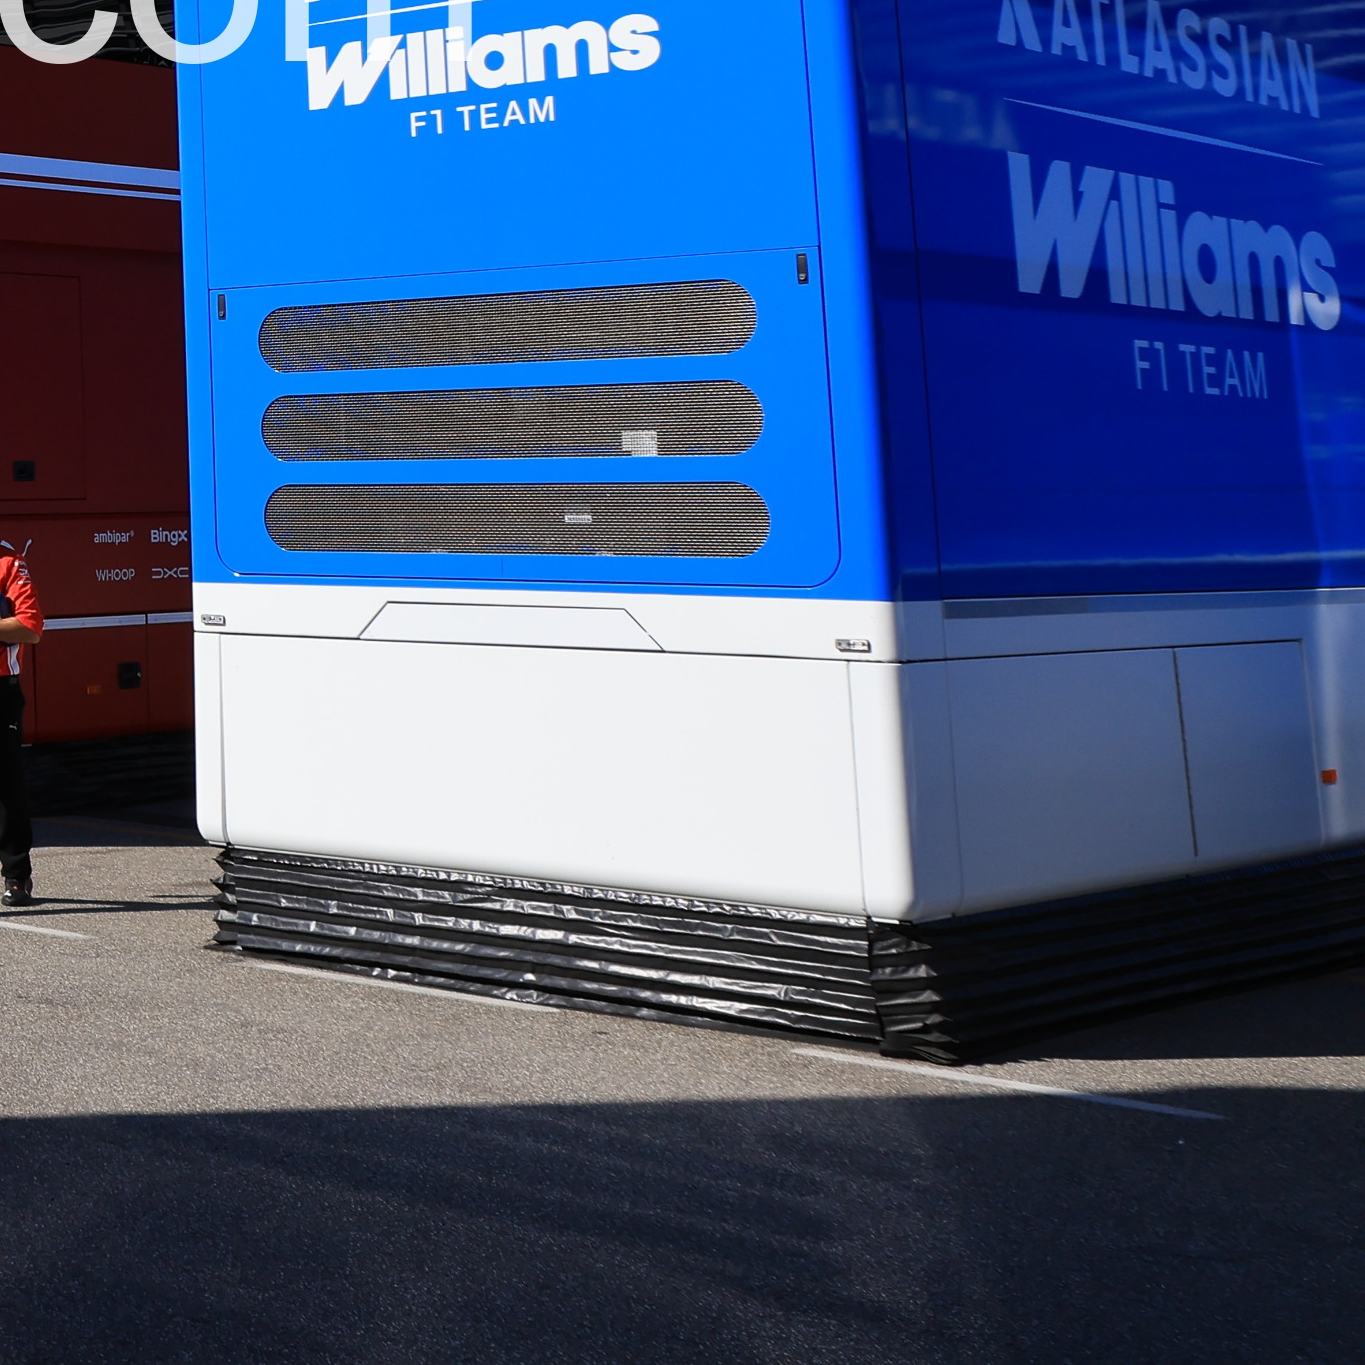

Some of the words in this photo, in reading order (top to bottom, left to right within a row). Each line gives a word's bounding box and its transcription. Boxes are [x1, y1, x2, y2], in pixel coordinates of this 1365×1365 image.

[306, 13, 661, 111] Williams
[410, 109, 444, 138] F1
[456, 95, 556, 132] TEAM
[1007, 150, 1342, 331] Williams
[1133, 339, 1169, 392] F1
[1178, 343, 1269, 399] TEAM
[95, 568, 136, 581] WHOOP
